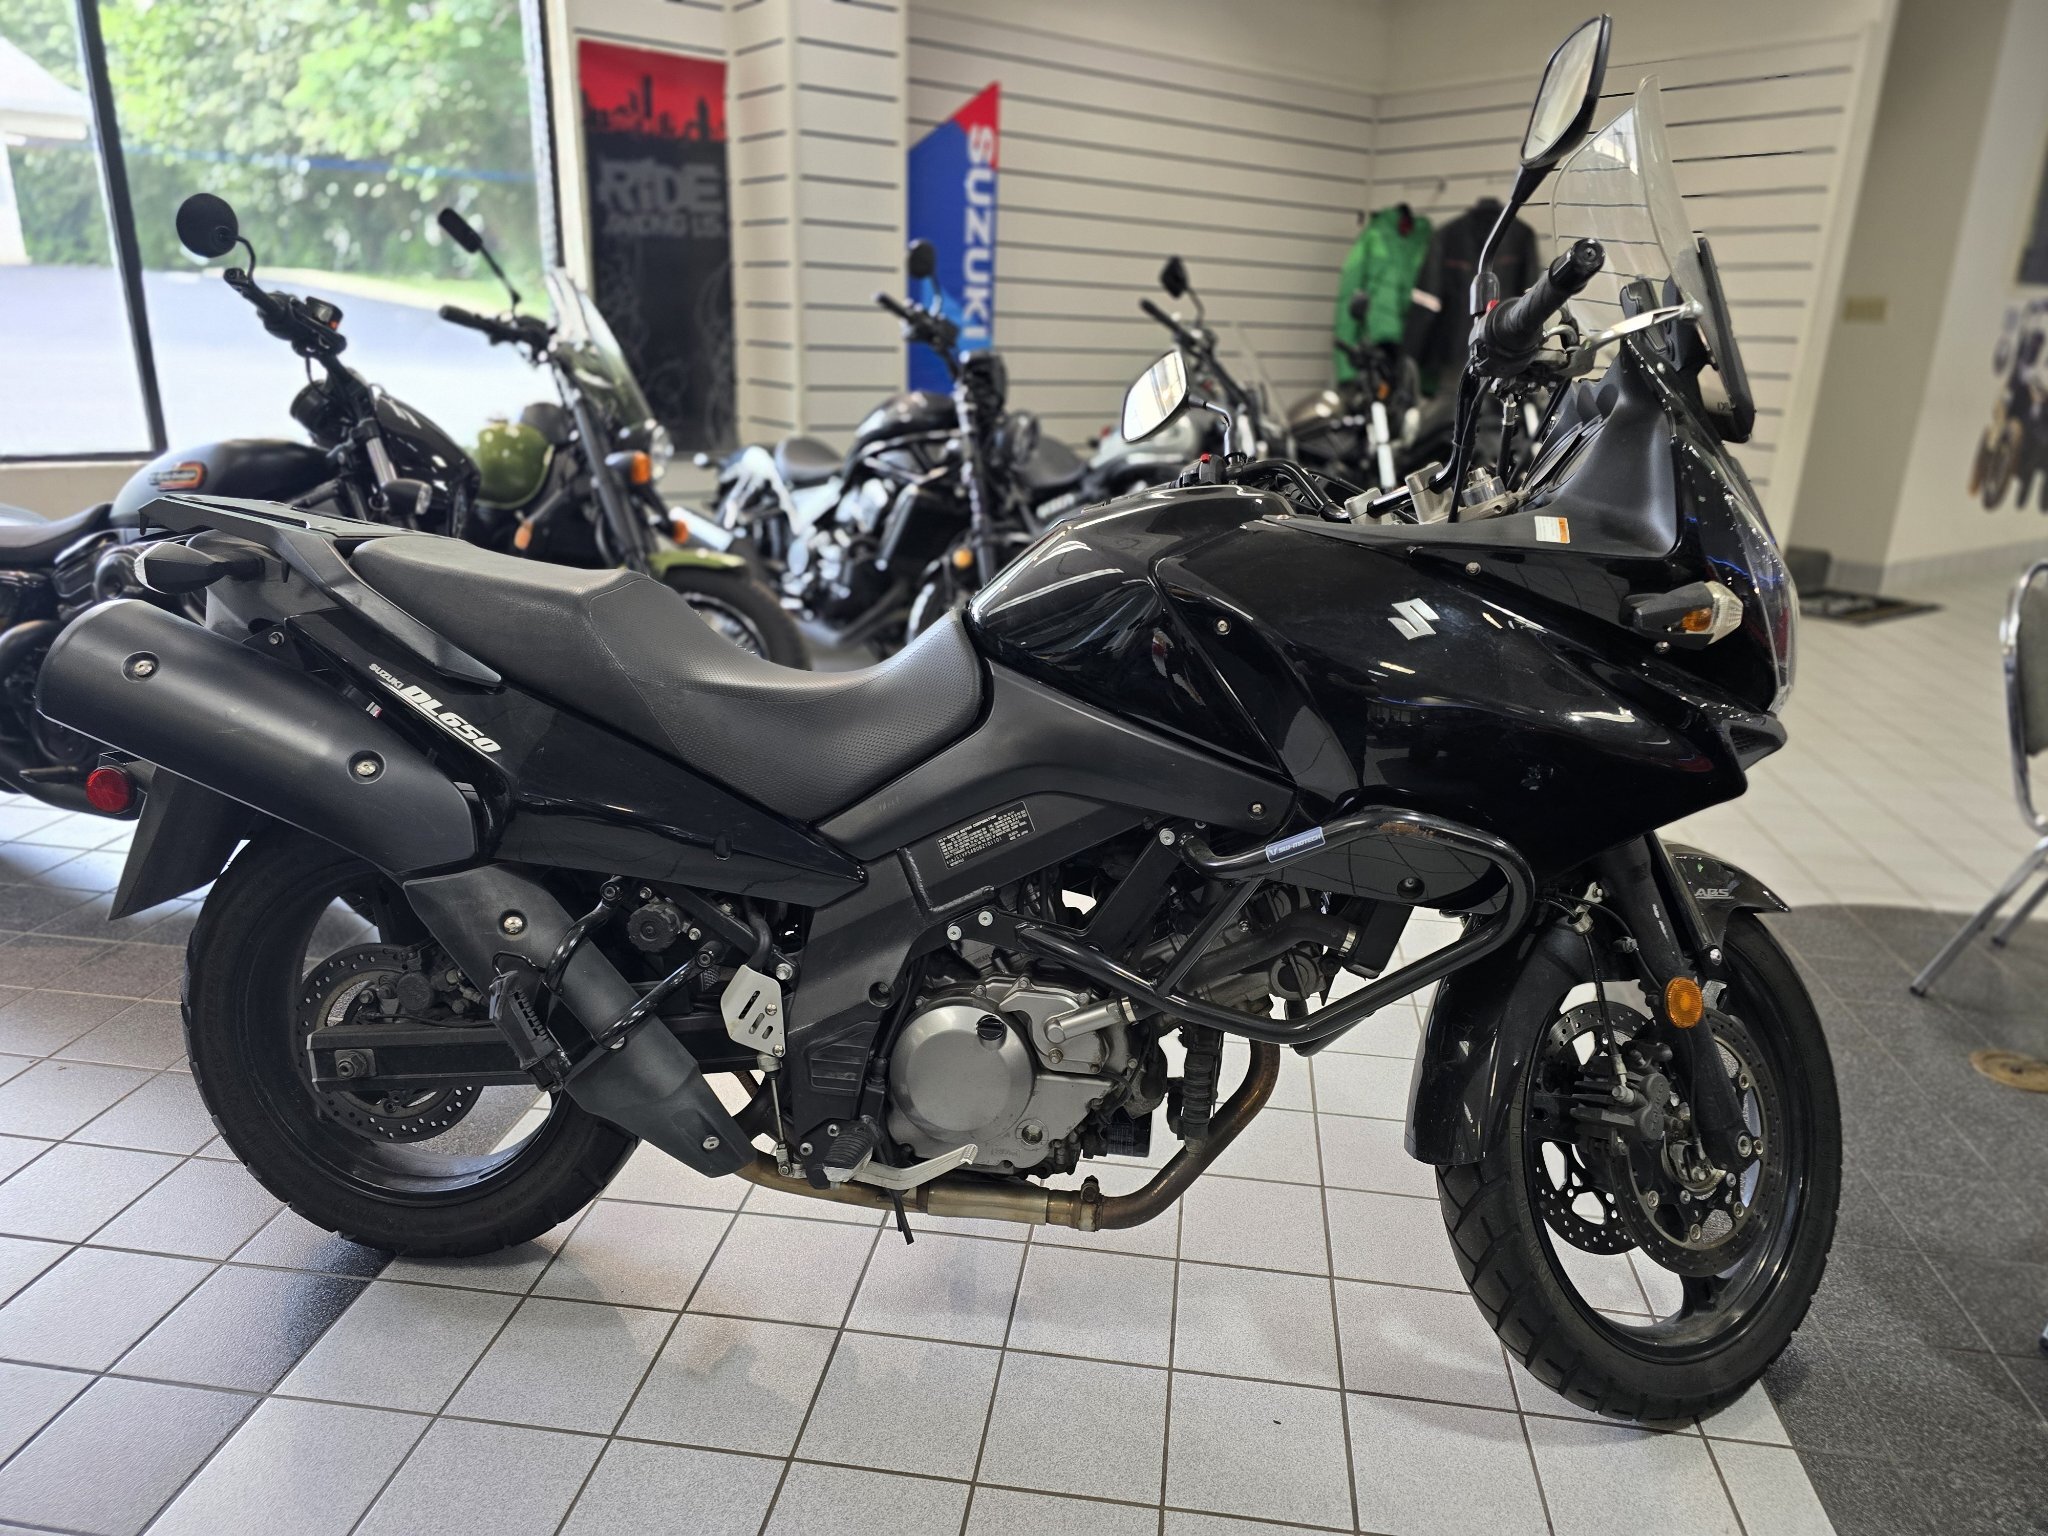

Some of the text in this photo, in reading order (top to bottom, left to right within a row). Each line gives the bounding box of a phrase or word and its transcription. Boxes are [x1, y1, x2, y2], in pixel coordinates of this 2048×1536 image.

[963, 124, 994, 339] SUZUKI
[369, 663, 404, 689] SUZUKI
[400, 685, 501, 752] DL650
[1694, 888, 1730, 897] ABS
